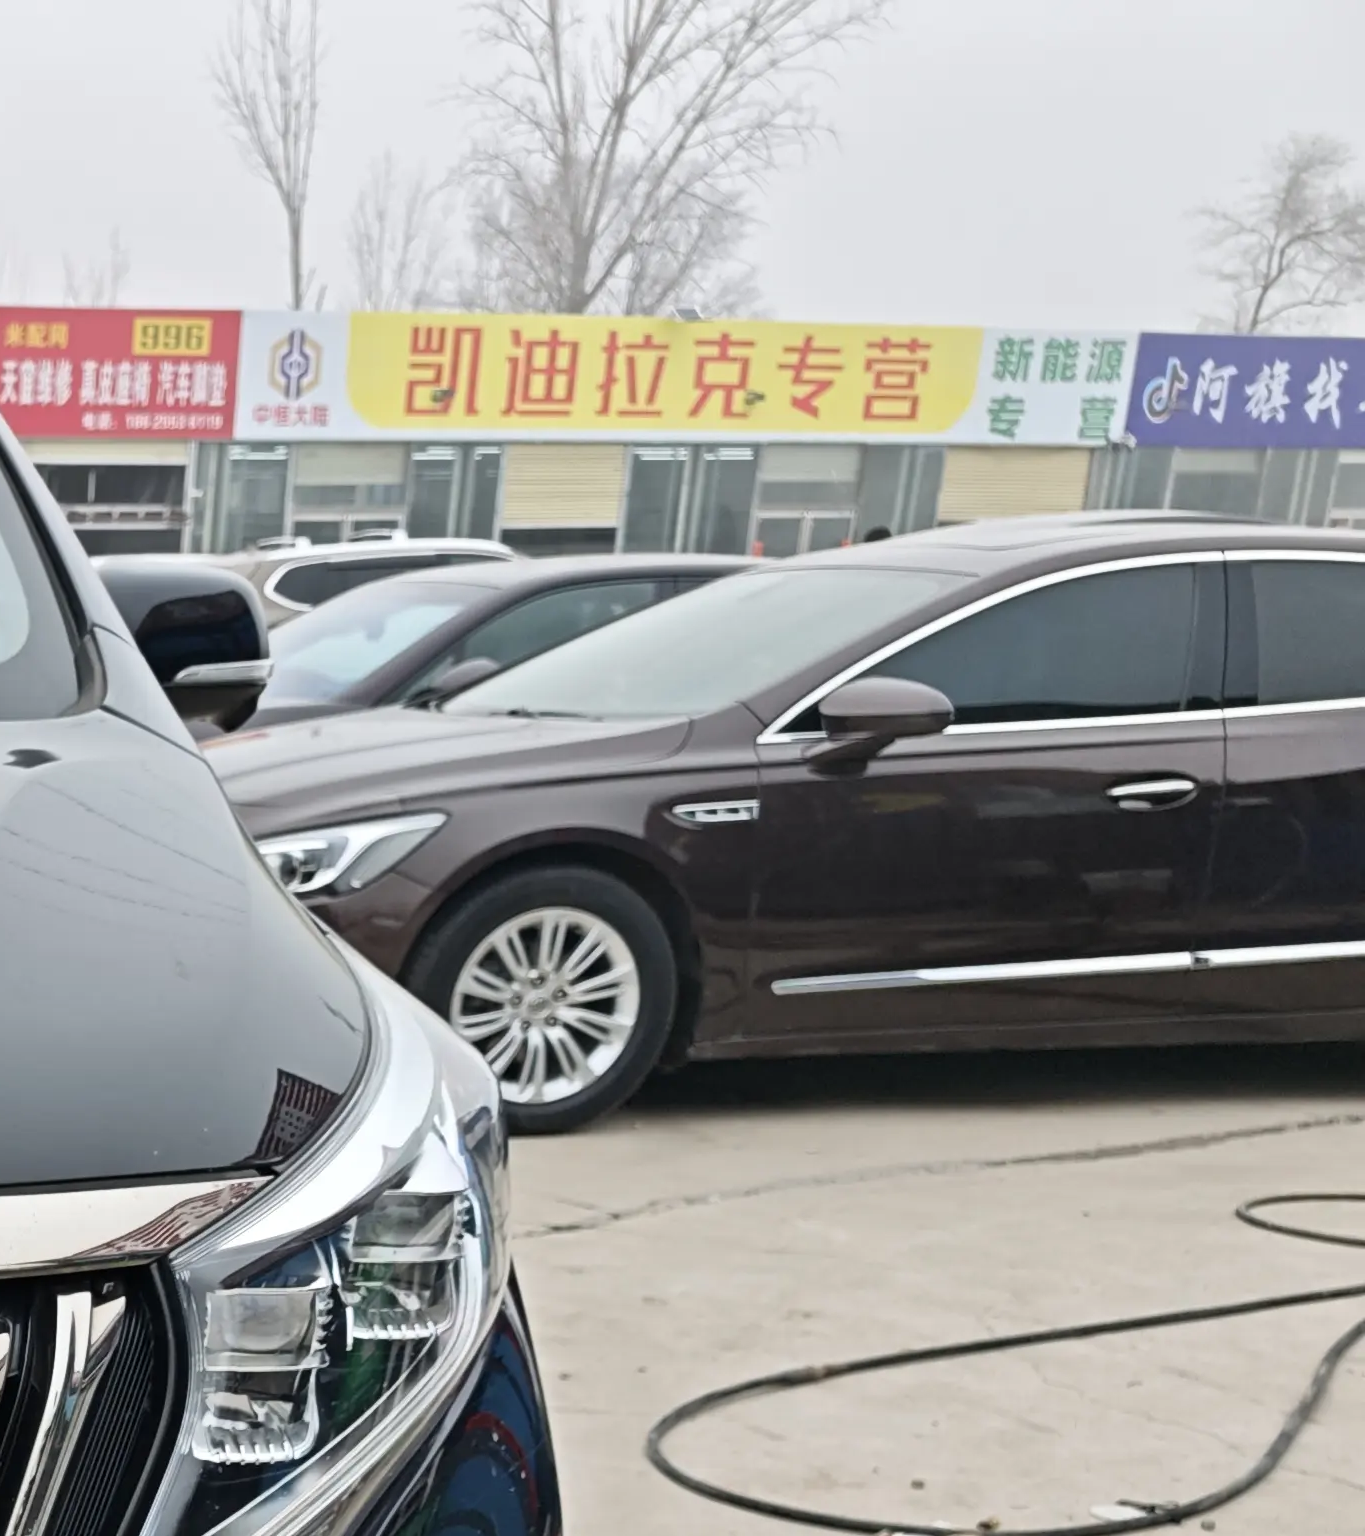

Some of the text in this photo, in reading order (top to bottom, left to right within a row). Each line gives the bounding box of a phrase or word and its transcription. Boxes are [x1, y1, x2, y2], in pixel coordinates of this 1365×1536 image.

[404, 325, 933, 423] 凯迪拉克专营
[992, 336, 1127, 384] 新能源
